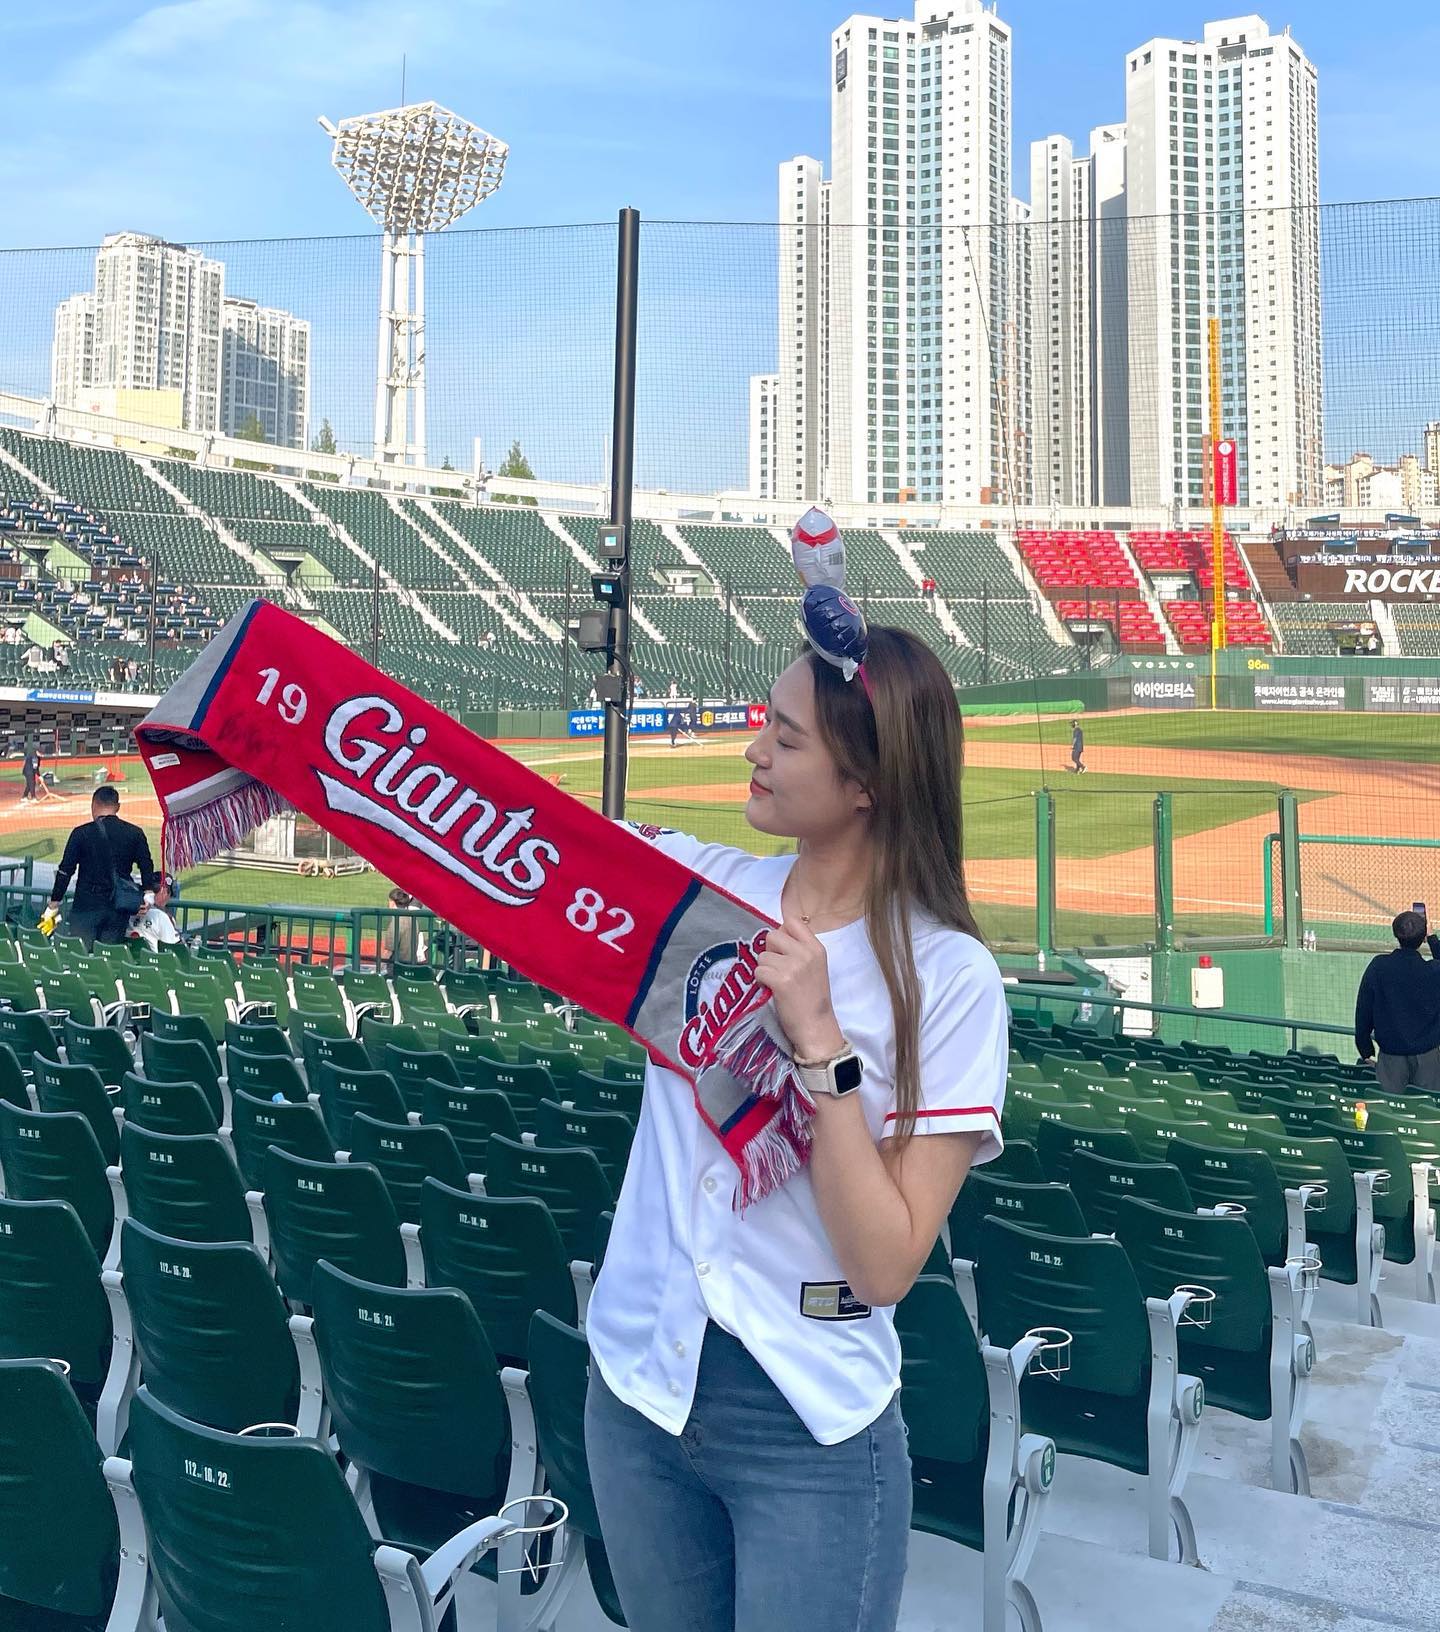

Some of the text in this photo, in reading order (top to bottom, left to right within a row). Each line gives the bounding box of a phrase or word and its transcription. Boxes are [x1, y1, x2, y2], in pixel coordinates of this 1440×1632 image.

[1131, 661, 1196, 669] VOLVO
[1247, 659, 1270, 670] 96m
[256, 667, 308, 725] 19
[1133, 682, 1195, 698] 아이언모터스
[322, 694, 562, 893] Giants
[565, 886, 635, 954] 82
[689, 956, 712, 995] LOTTE
